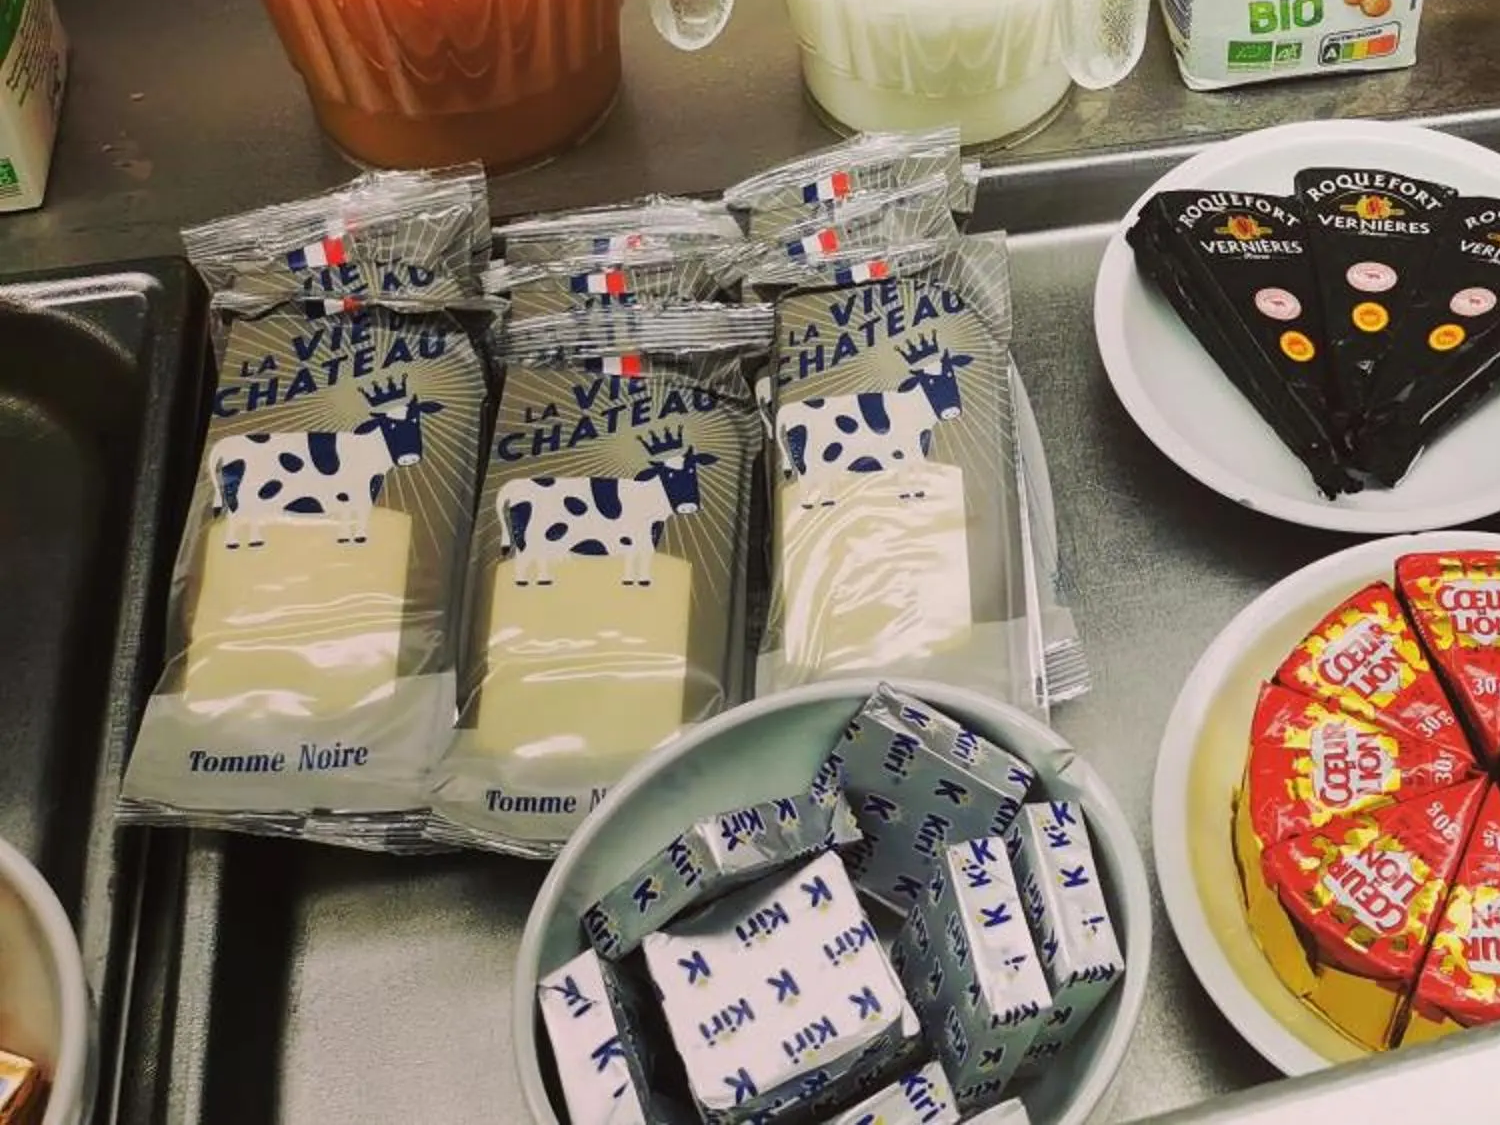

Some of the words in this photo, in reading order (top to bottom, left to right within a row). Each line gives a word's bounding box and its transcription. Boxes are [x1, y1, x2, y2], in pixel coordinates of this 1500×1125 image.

[1307, 172, 1442, 211] ROQUEFORT
[1179, 193, 1300, 228] ROQUEFORT
[829, 278, 900, 326] VIE
[292, 316, 373, 361] VIE
[789, 325, 819, 347] LA
[213, 332, 446, 418] CHATEAU
[240, 355, 279, 377] LA
[572, 375, 648, 411] VIE
[497, 387, 717, 462] CHATEAU
[524, 403, 560, 424] LA
[1349, 649, 1401, 697] LION
[902, 706, 931, 727] K
[189, 748, 285, 773] Tomme
[299, 744, 368, 772] Noire
[884, 733, 920, 776] Kiri
[952, 730, 979, 764] Kiri
[485, 788, 577, 814] Tomme
[864, 795, 897, 821] K
[935, 779, 967, 805] K
[915, 814, 951, 857] Kiri
[668, 834, 702, 887] Kiri
[1060, 865, 1090, 888] K
[1360, 844, 1424, 904] LION
[633, 878, 658, 913] K
[800, 875, 834, 907] K
[582, 902, 619, 954] Kiri
[735, 901, 790, 947] Kiri
[981, 903, 1012, 928] K
[823, 920, 876, 967] Kiri
[677, 950, 712, 985] K
[767, 968, 800, 1003] K
[848, 986, 882, 1020] K
[700, 997, 756, 1047] Kiri
[782, 1015, 838, 1064] Kiri
[724, 1067, 759, 1105] K
[900, 1074, 946, 1123] Kiri
